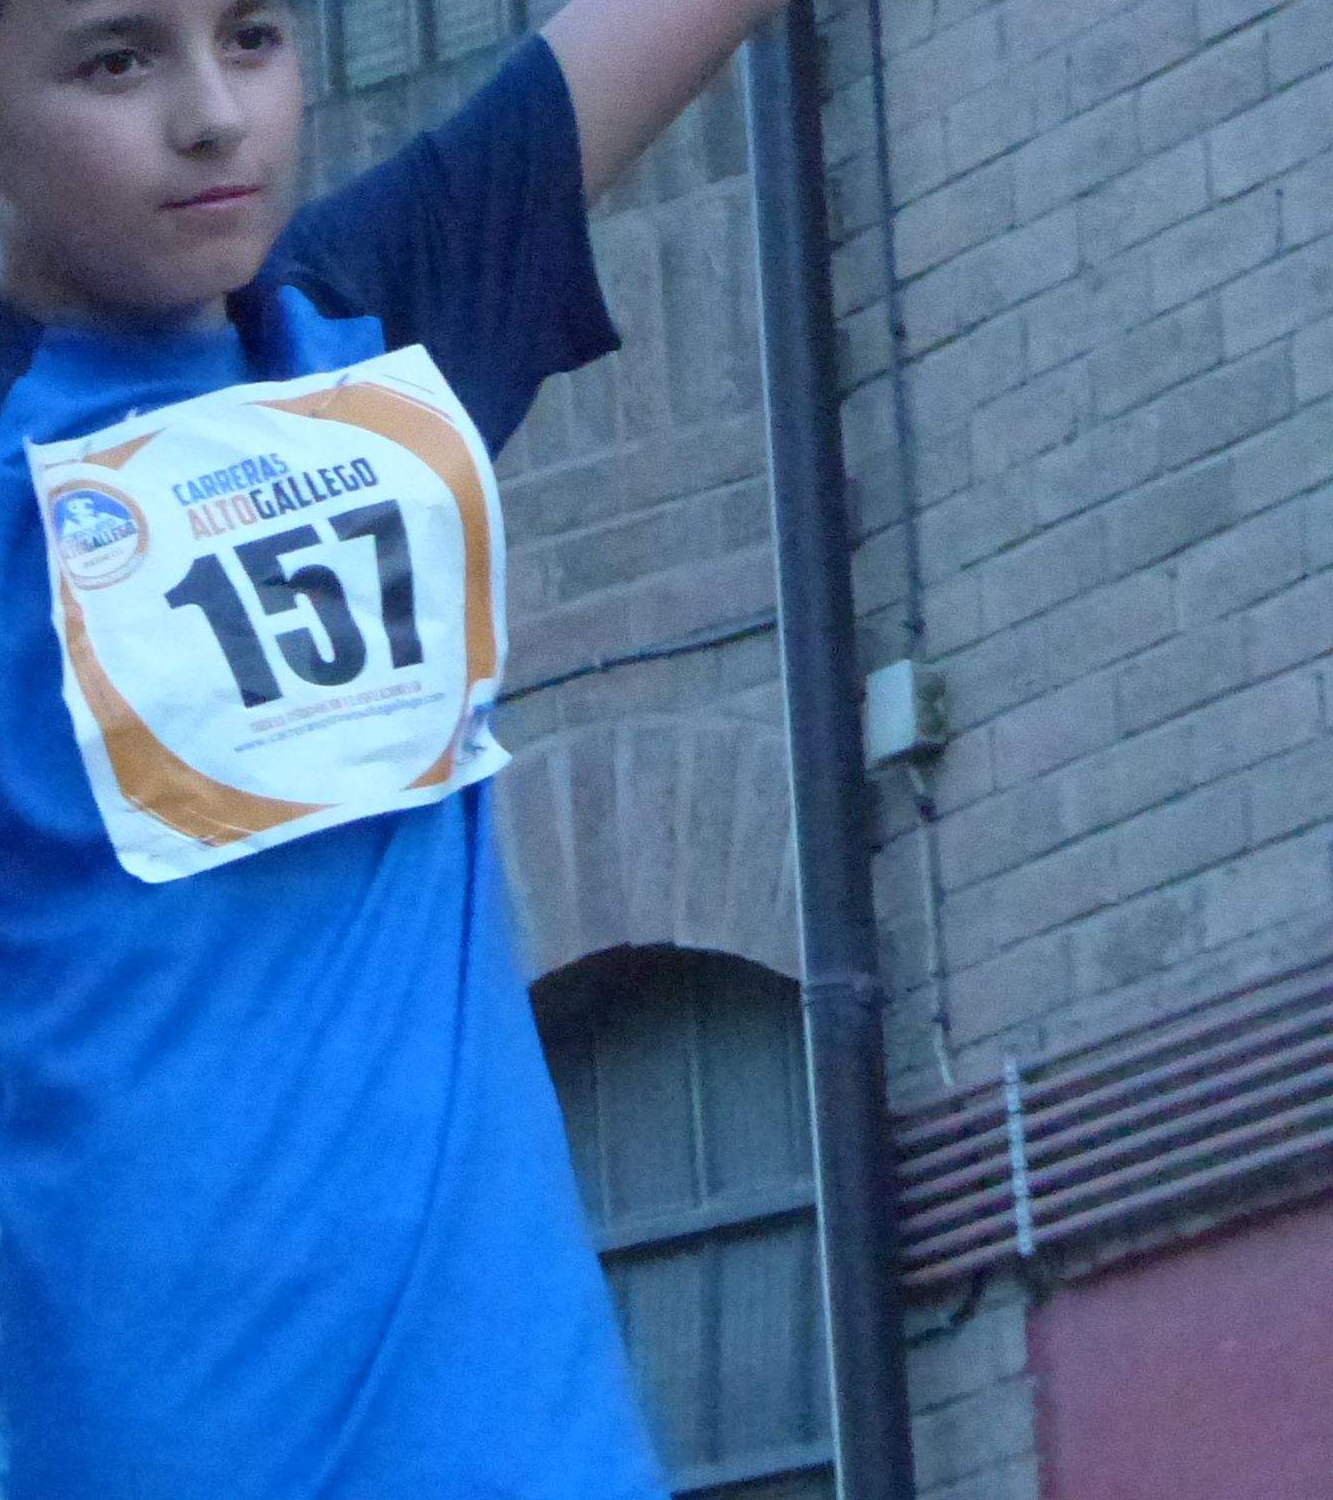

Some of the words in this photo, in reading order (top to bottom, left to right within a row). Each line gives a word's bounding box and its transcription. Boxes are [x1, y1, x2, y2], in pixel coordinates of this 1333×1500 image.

[172, 453, 290, 506] CARRERAS
[188, 457, 378, 540] ALTOGALLEGO
[164, 499, 423, 709] 157
